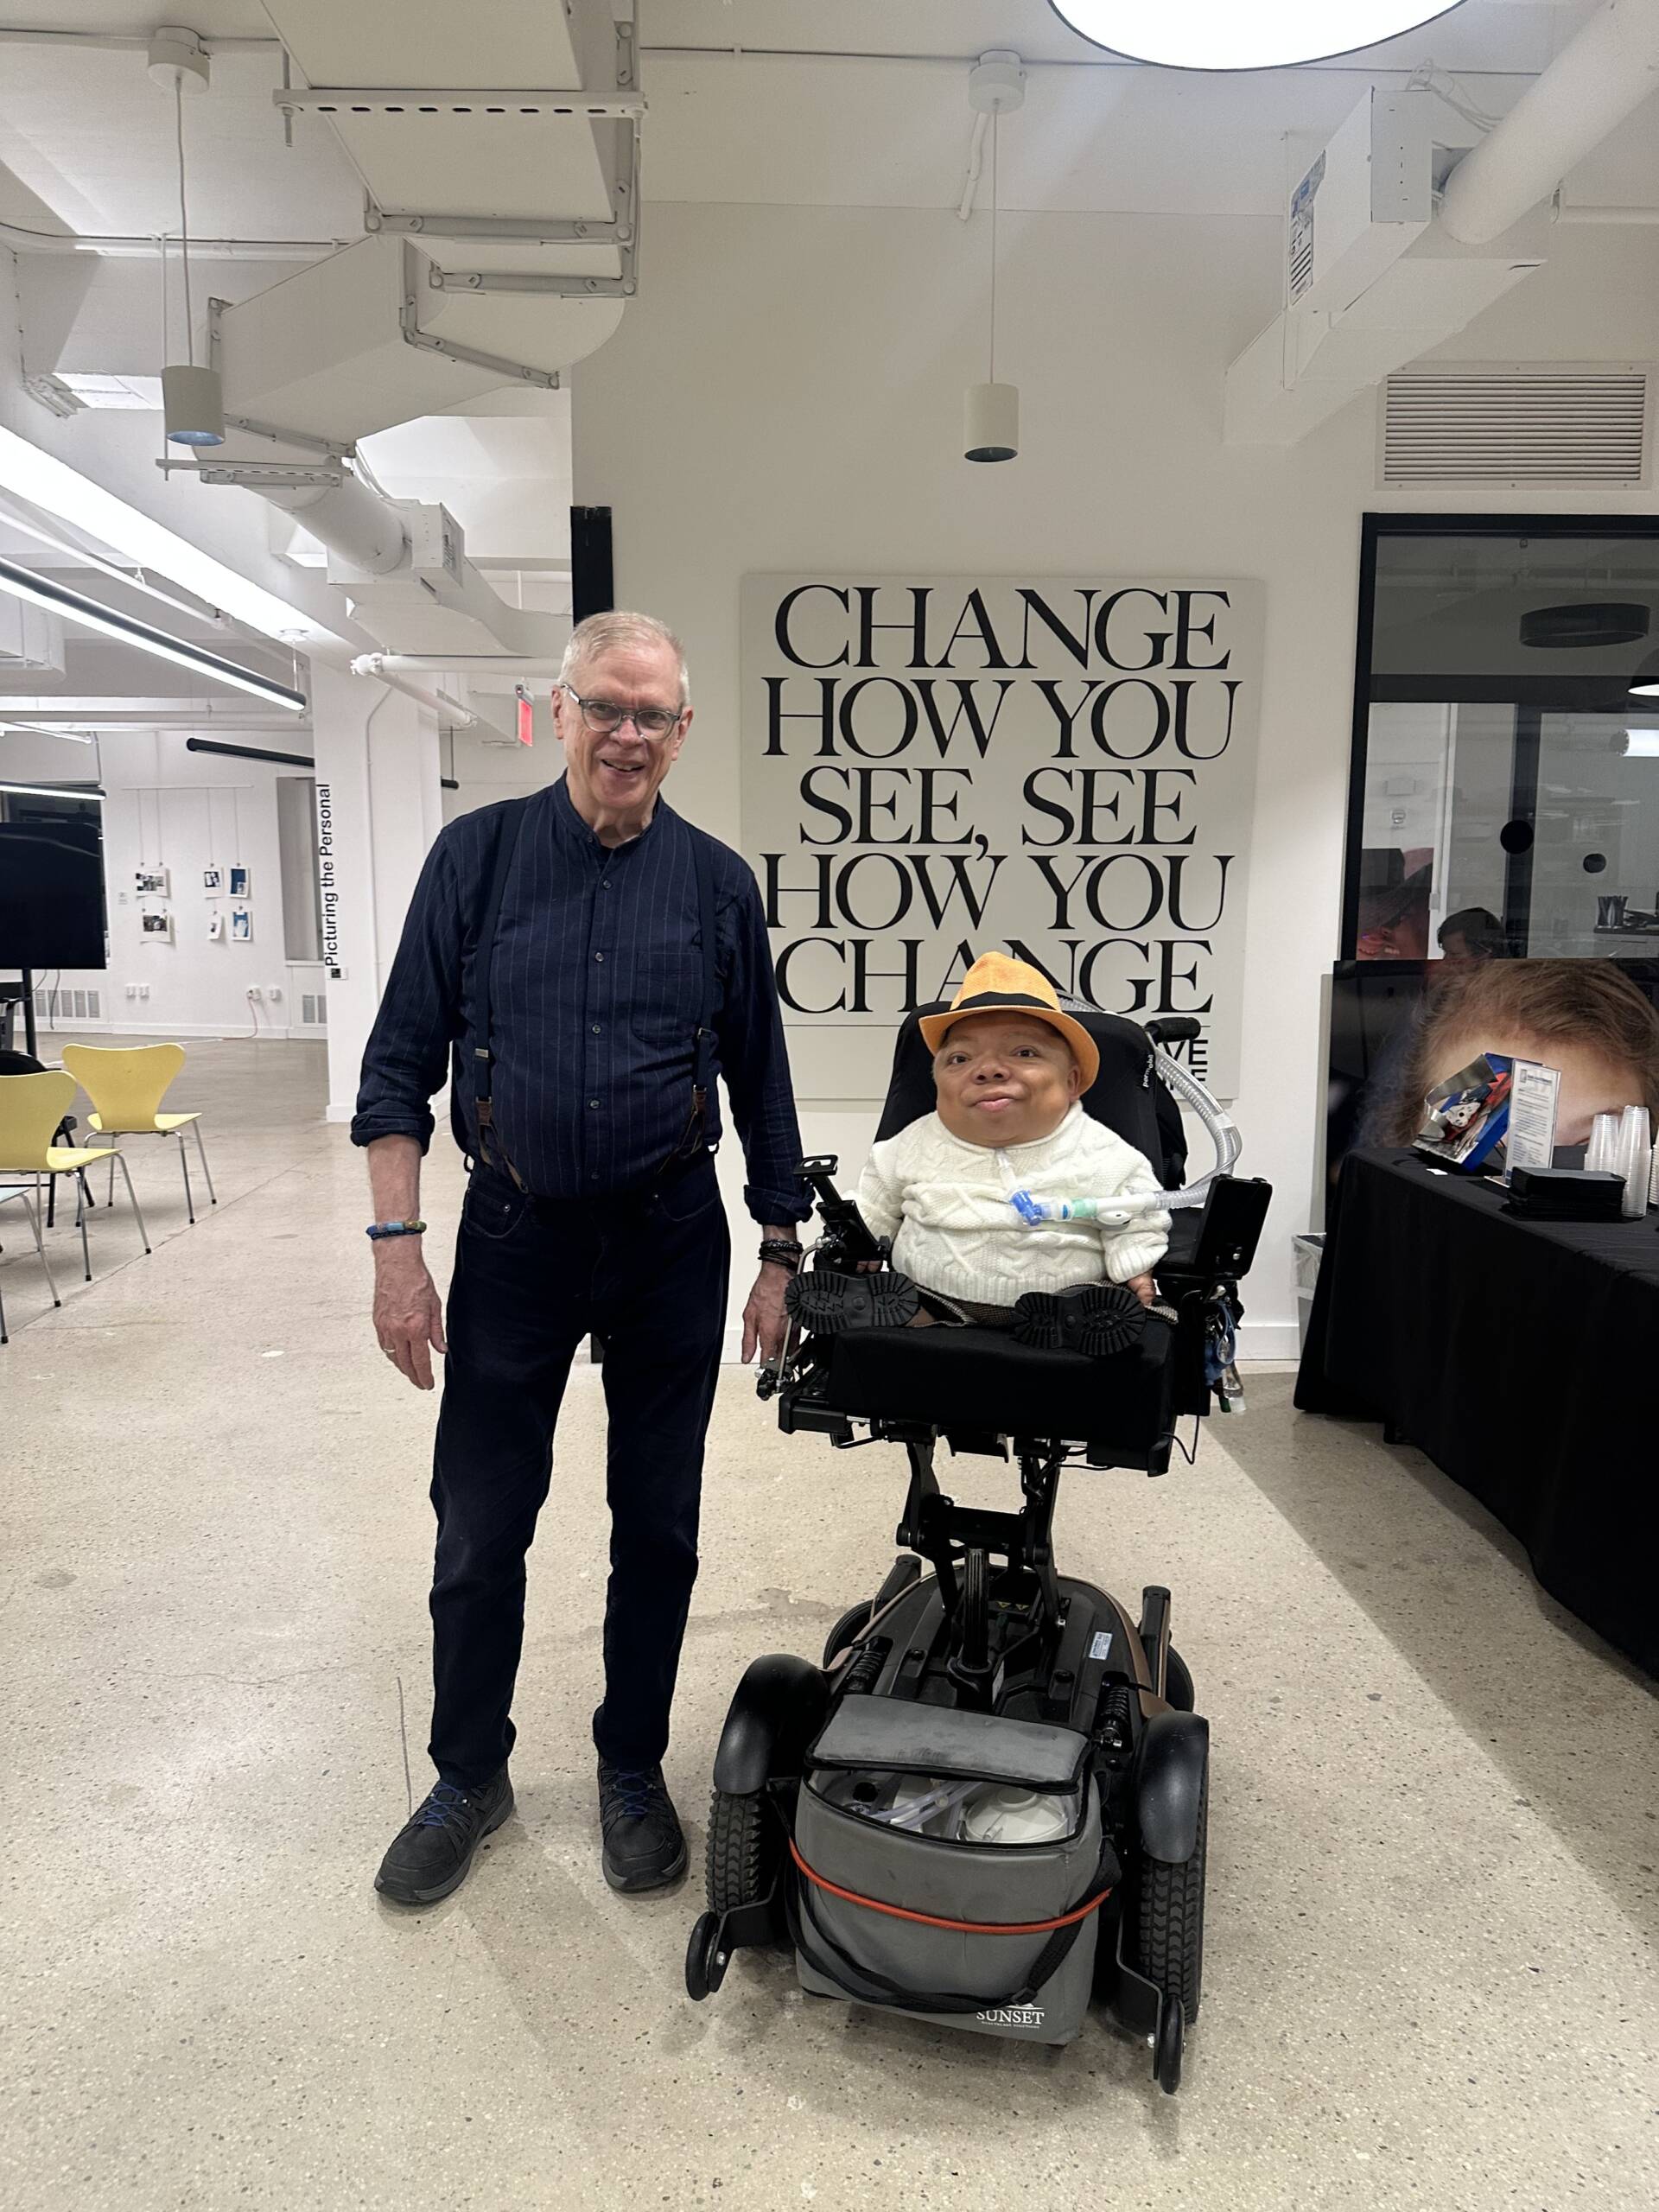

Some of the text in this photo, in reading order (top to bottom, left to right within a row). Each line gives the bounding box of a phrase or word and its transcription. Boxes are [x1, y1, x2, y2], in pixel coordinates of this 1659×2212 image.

[774, 584, 1231, 671] CHANGE
[761, 677, 1243, 760] HOW YOU
[799, 766, 1198, 861] SEE, SEE
[315, 784, 339, 967] Picturing the Personal
[760, 853, 1236, 931] HOW YOU
[976, 2009, 1044, 2024] SUNSET
